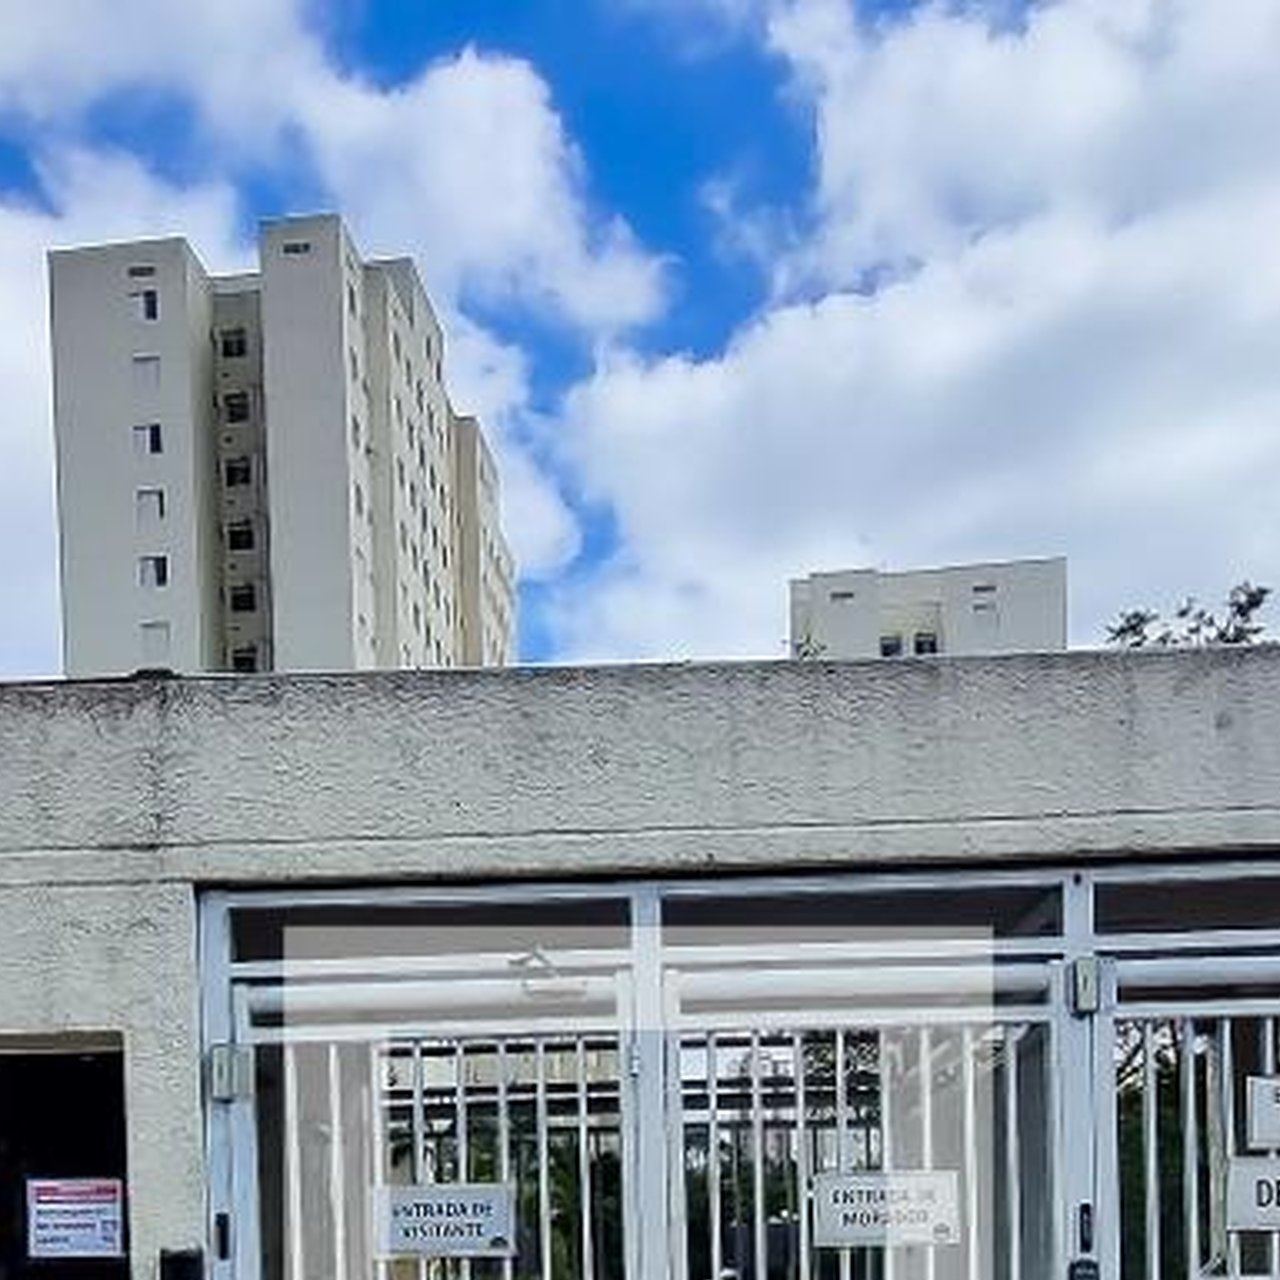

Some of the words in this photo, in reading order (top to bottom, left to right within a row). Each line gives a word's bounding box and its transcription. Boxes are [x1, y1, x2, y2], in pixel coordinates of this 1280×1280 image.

[392, 1201, 468, 1218] ENTRADA
[473, 1201, 493, 1217] DE
[402, 1221, 484, 1239] VISITANTE
